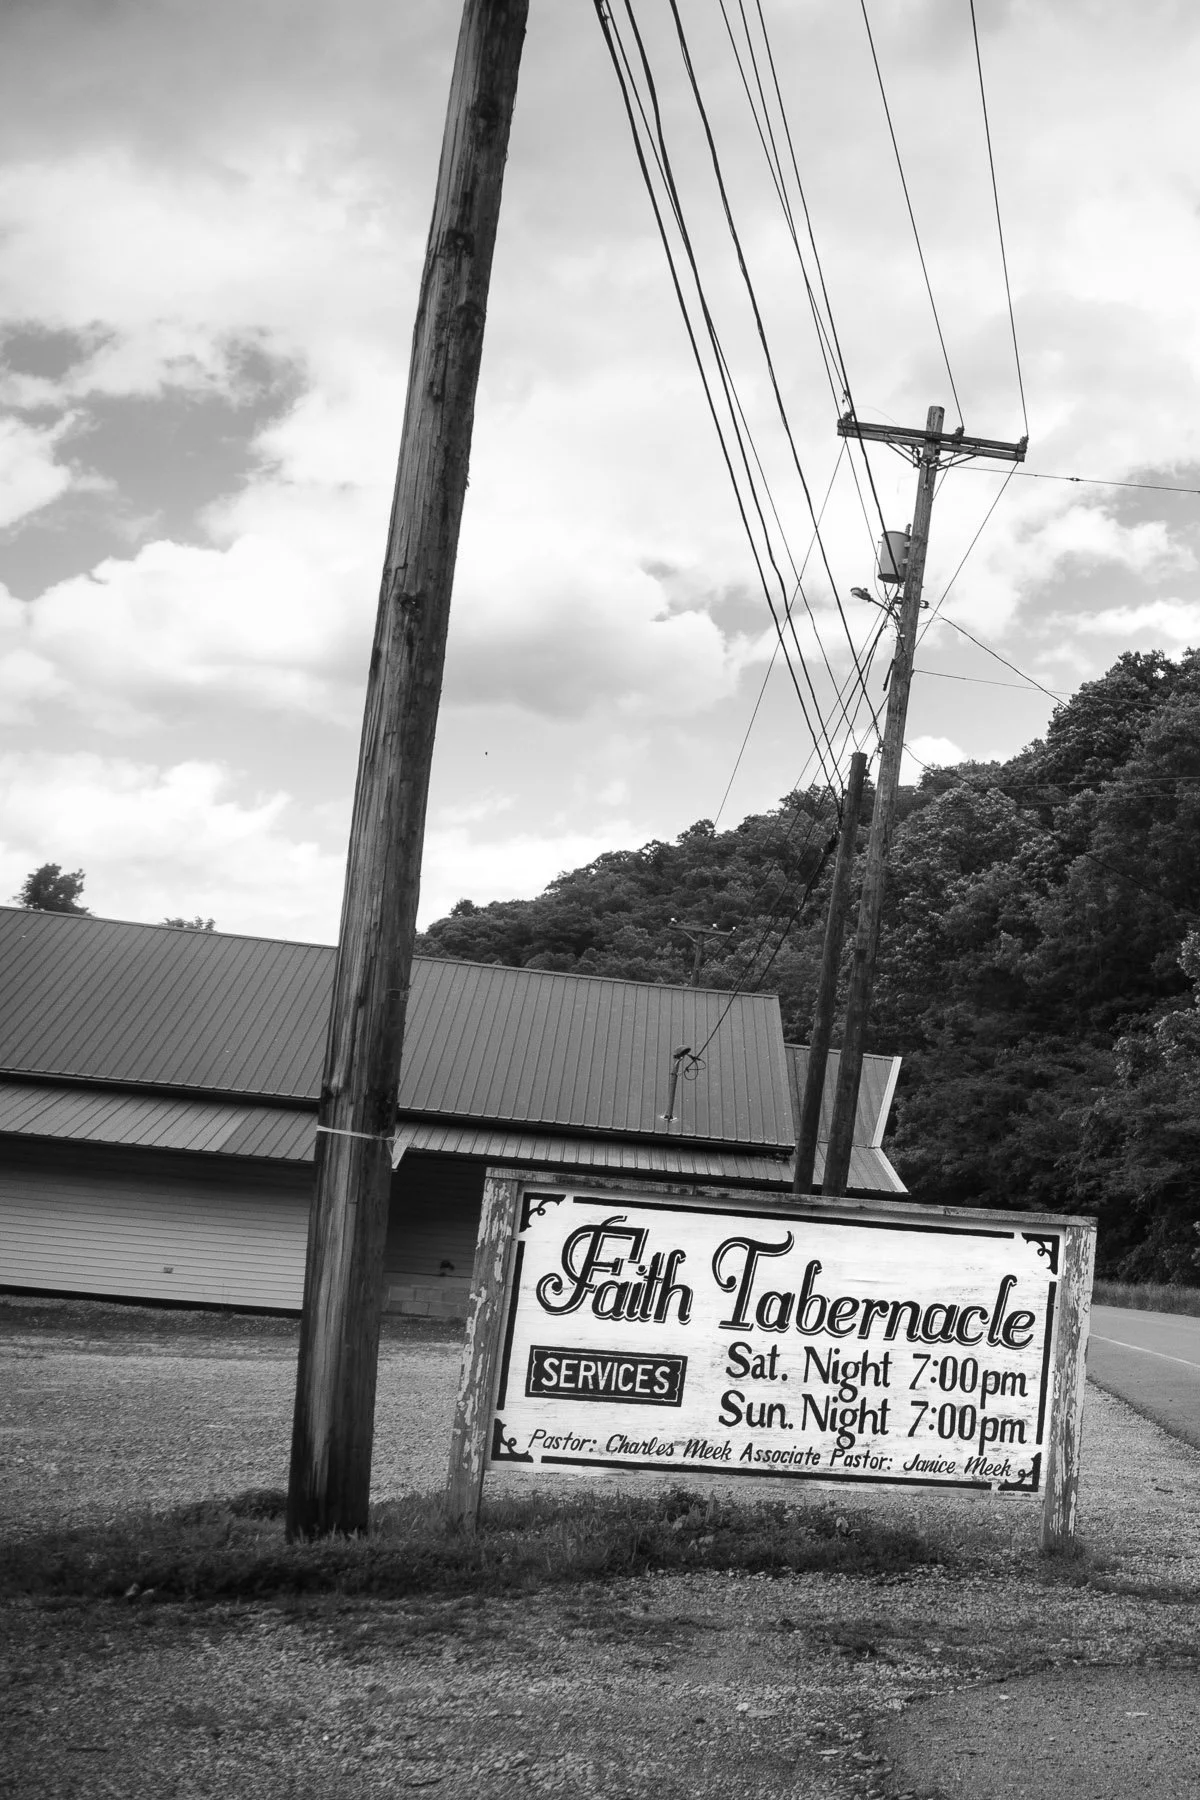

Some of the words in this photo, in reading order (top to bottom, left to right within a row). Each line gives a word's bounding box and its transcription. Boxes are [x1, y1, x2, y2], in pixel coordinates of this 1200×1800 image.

[536, 1215, 693, 1325] Faith
[712, 1231, 1037, 1350] Tabernacle
[541, 1358, 671, 1395] SERVICES
[726, 1341, 788, 1382] Sat.
[803, 1346, 892, 1402] Night
[908, 1353, 1029, 1409] 7:00pm
[528, 1429, 597, 1451] Pastor:
[606, 1434, 675, 1457] Charles
[683, 1439, 732, 1461] Meek
[739, 1442, 821, 1467] Associate
[830, 1448, 893, 1471] Pastor:
[903, 1453, 956, 1475] Janice
[964, 1456, 1011, 1477] Meek
[718, 1390, 794, 1429] Sun.
[801, 1394, 891, 1449] Night
[907, 1401, 1028, 1456] 7:00pm
